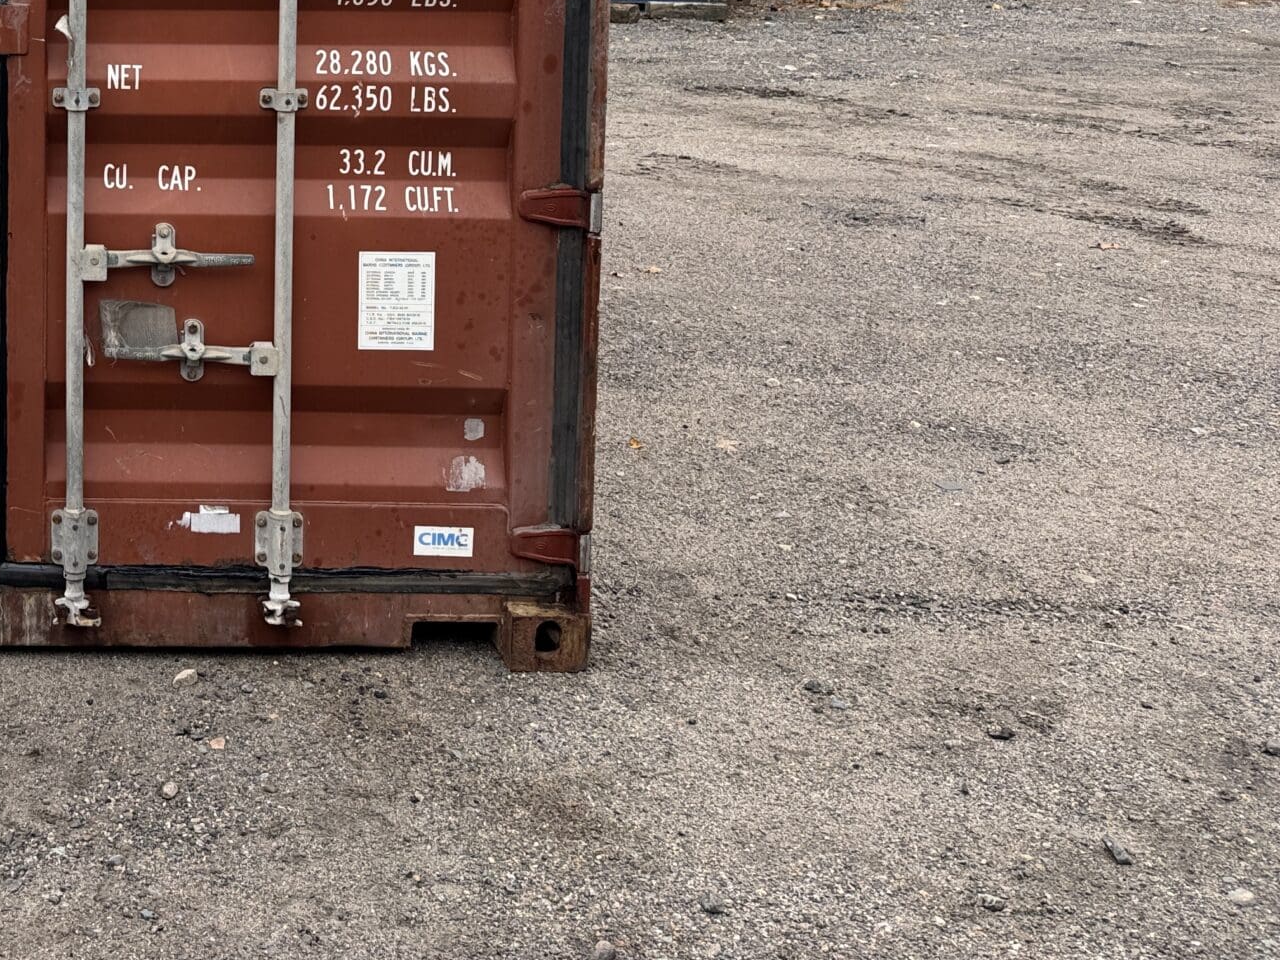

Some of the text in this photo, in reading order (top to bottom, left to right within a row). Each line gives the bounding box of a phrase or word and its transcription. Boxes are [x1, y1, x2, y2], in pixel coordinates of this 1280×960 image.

[315, 49, 458, 78] 28,280 KGS.
[107, 64, 143, 91] NET
[410, 86, 457, 113] LBS.
[339, 148, 457, 178] 33.2 CU.M.
[103, 163, 202, 192] CU. CAP.
[405, 186, 460, 213] CU.FT.
[418, 532, 469, 547] CIMC
